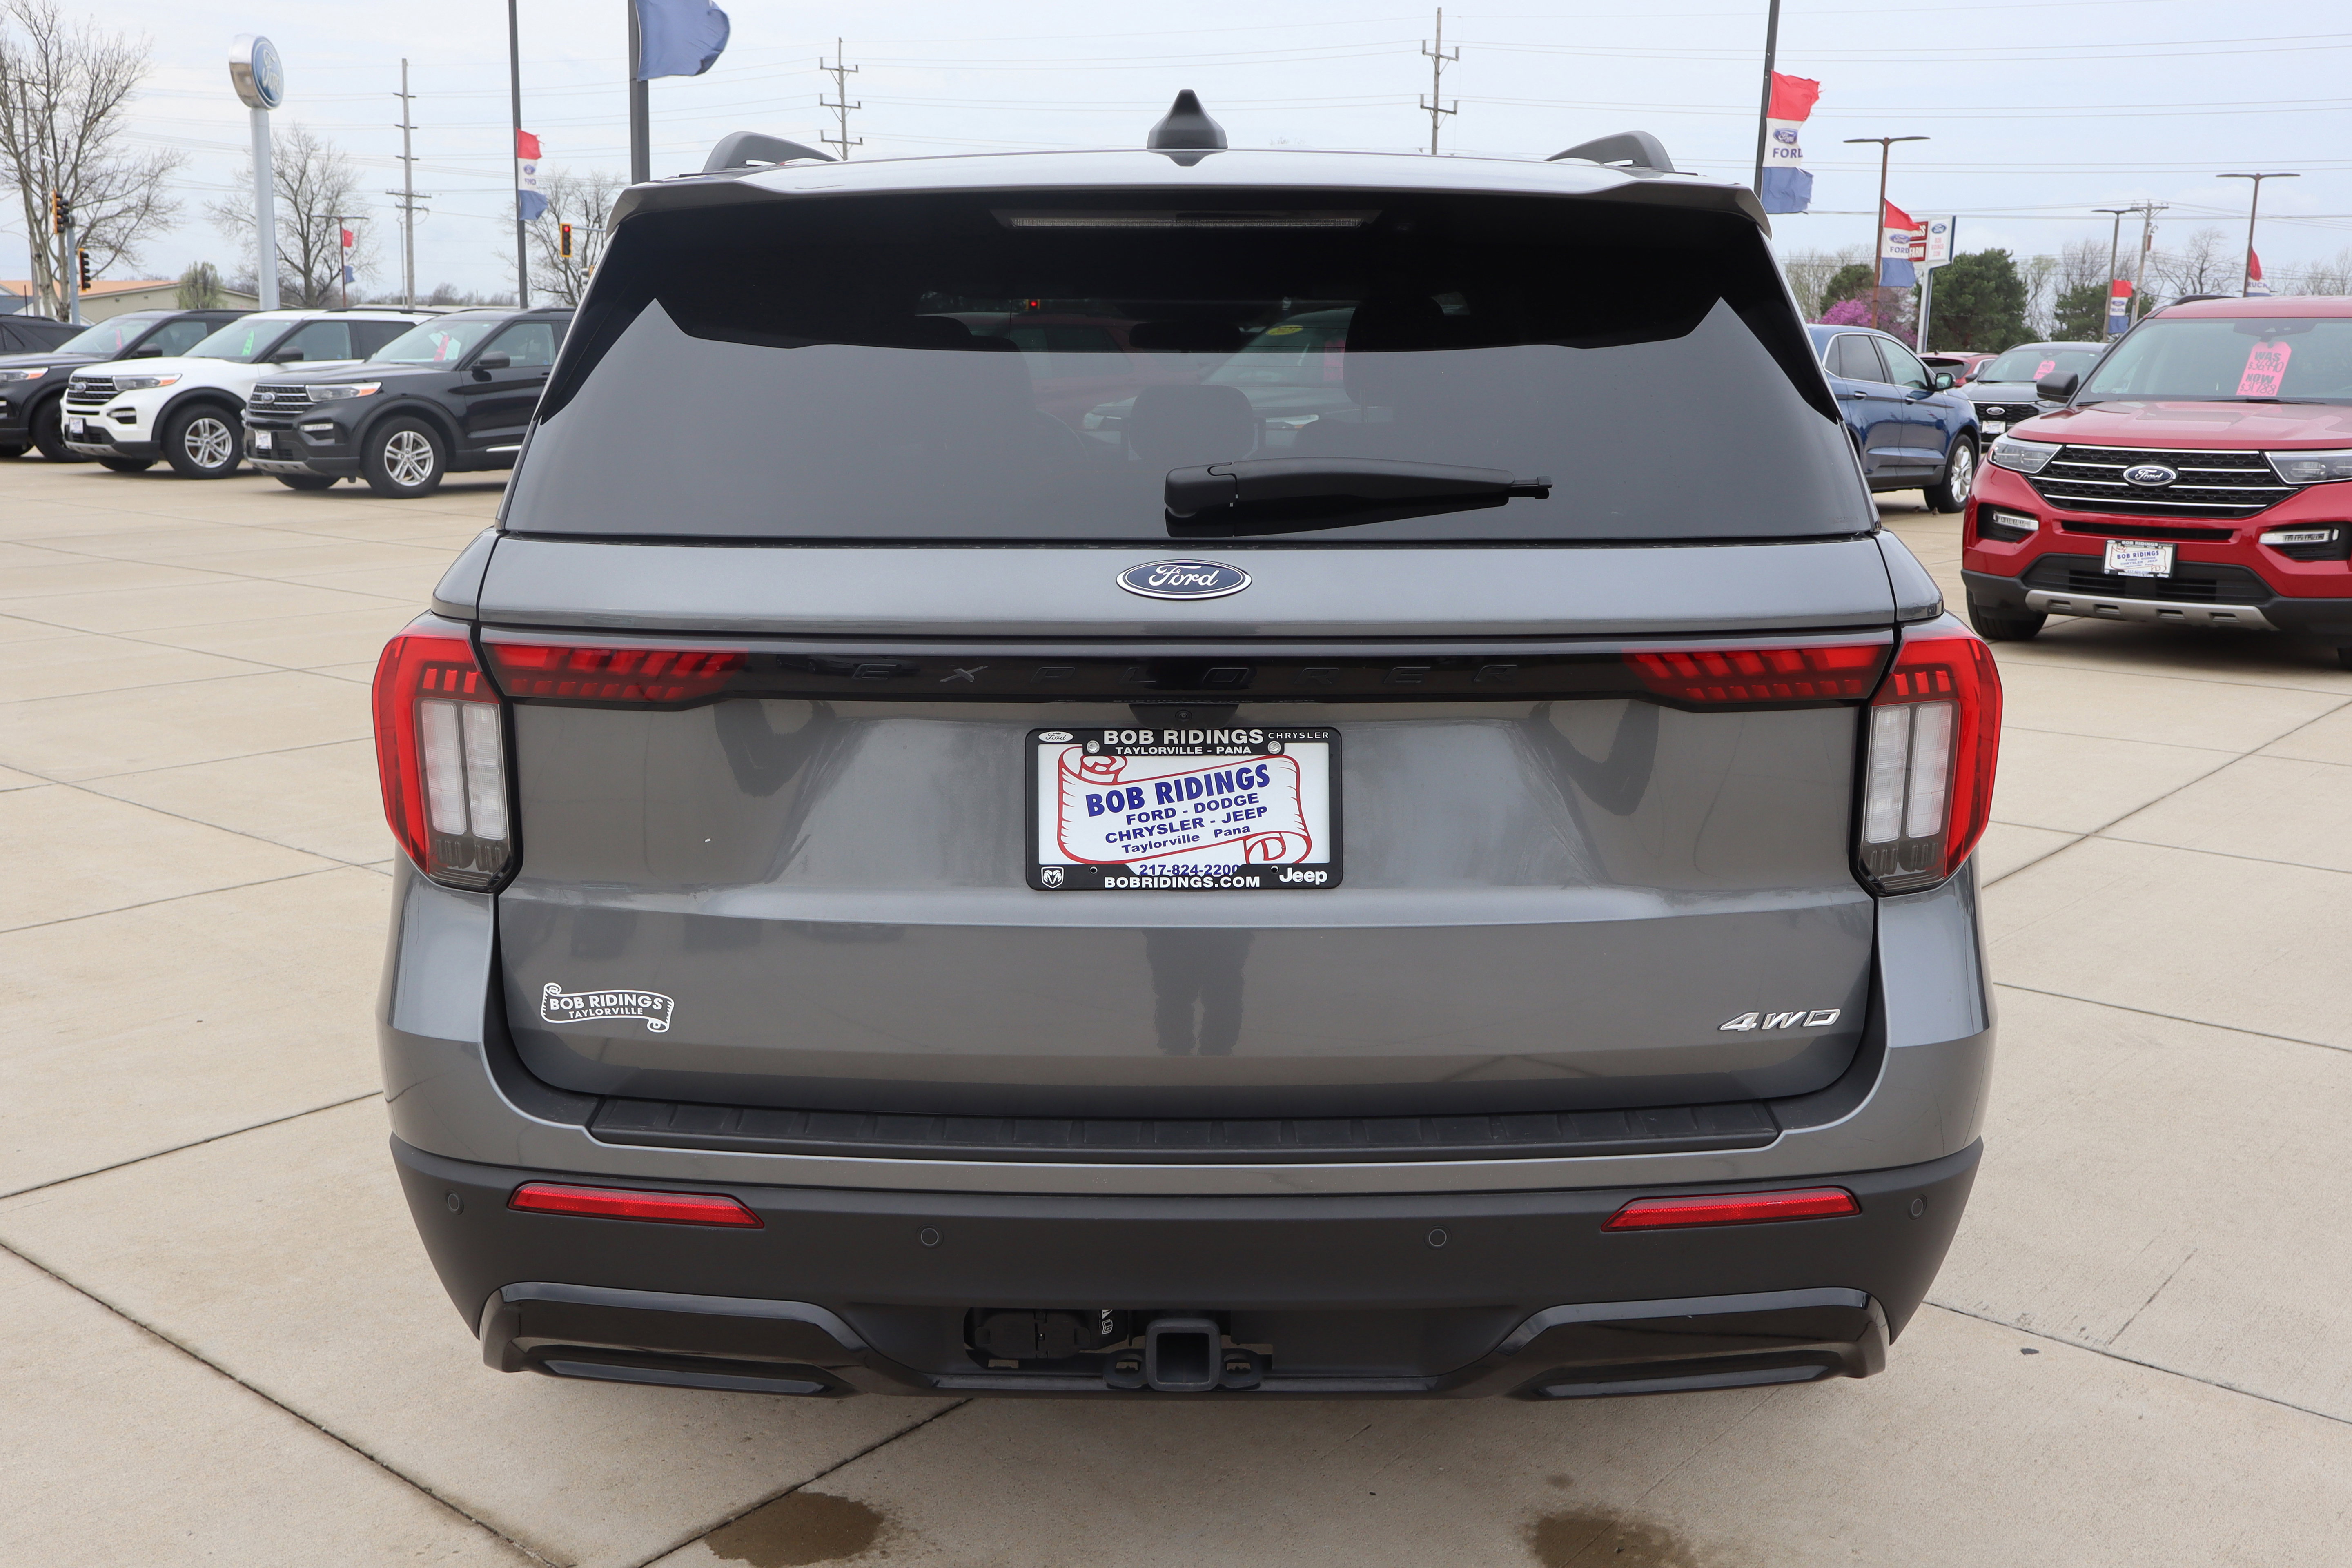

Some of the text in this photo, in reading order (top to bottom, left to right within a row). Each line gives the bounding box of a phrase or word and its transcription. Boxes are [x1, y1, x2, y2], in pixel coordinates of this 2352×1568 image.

[2254, 352, 2282, 362] WAS
[2246, 374, 2275, 384] NOW
[2135, 469, 2163, 480] Ford
[1148, 564, 1220, 586] Ford
[851, 664, 1518, 684] EXPLORER
[1045, 732, 1067, 741] Ford
[1104, 729, 1264, 744] BOB RIDINGS
[1115, 746, 1203, 755] TAYLORVILLE
[1216, 746, 1252, 754] PANA
[1085, 764, 1270, 817] BOB RIDINGS
[1126, 807, 1177, 825] FORD
[1194, 792, 1259, 814] DODGE
[1105, 817, 1205, 844] CHRYSLER
[1221, 806, 1268, 824] JEEP
[1121, 826, 1251, 853] Taylorville Pana
[1139, 864, 1240, 875] 217-824-2200
[1279, 867, 1328, 885] Jeep
[1104, 876, 1260, 888] BOBRIDINGS.COM
[550, 993, 664, 1010] BOB RIDINGS
[568, 1007, 643, 1019] TAYLORVILLE
[1718, 1008, 1841, 1032] 4WD
